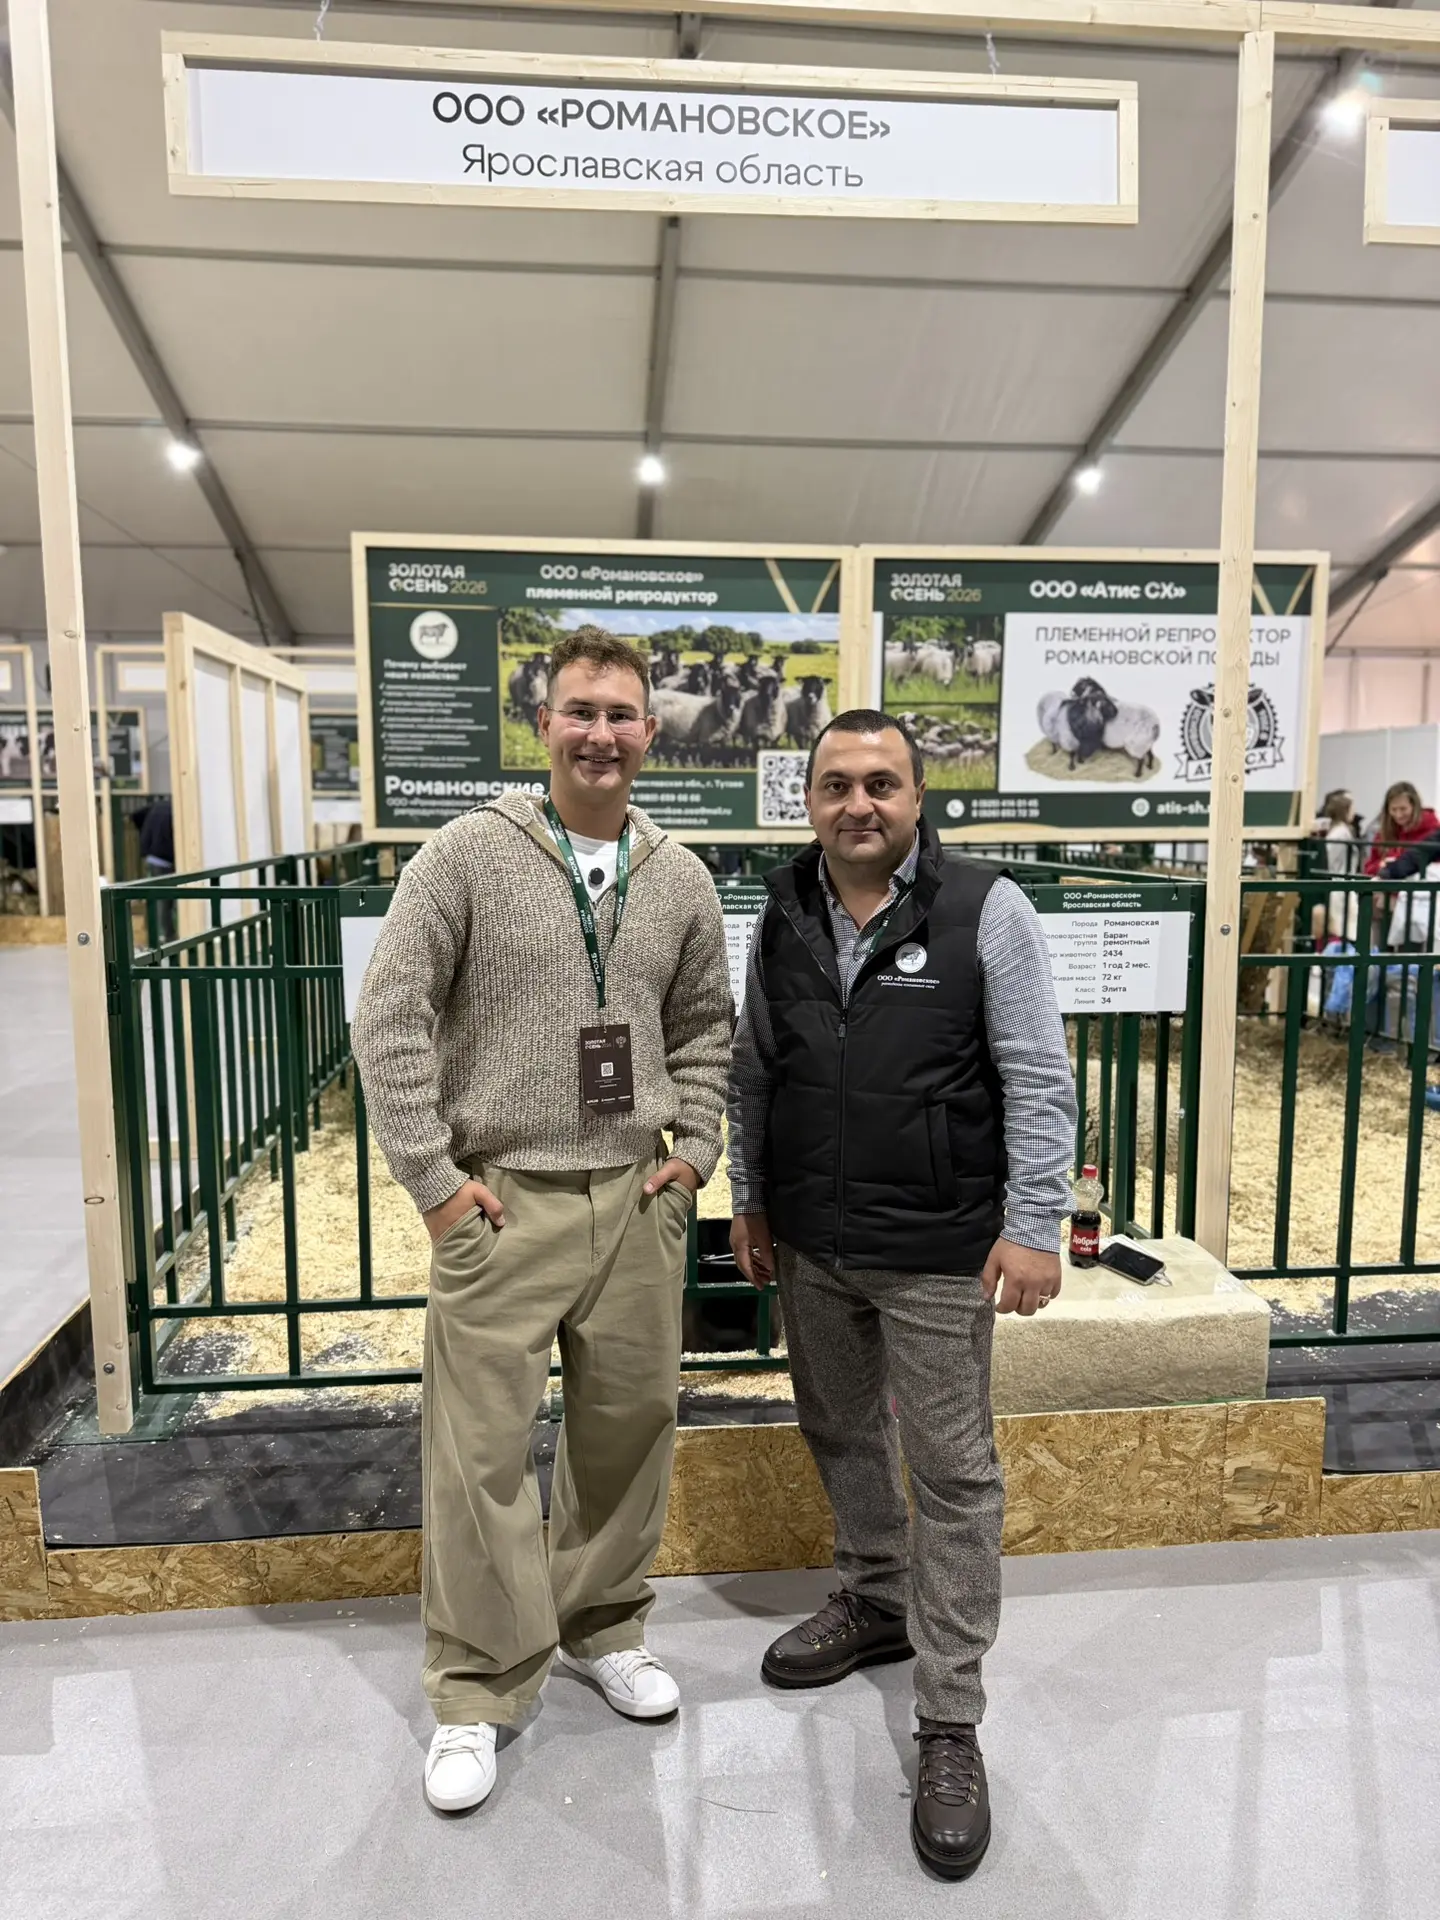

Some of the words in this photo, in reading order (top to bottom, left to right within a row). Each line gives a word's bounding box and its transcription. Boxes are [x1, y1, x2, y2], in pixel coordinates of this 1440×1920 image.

[432, 91, 525, 126] ООО
[537, 98, 891, 140] «РОМАНОВСКОЕ»
[462, 143, 703, 182] Ярославская
[716, 153, 864, 187] область
[388, 563, 466, 579] ЗОЛОТАЯ
[540, 565, 578, 580] ООО
[580, 566, 704, 584] «Романовское»
[388, 578, 449, 593] ОСЕНЬ
[450, 580, 488, 594] 2026
[890, 573, 962, 588] ЗОЛОТАЯ
[526, 585, 613, 601] племенной
[615, 588, 719, 606] репродуктор
[890, 588, 945, 601] ОСЕНЬ
[946, 588, 981, 602] 2026
[1029, 580, 1076, 599] ООО
[1080, 581, 1141, 599] «Атис
[1144, 582, 1187, 600] СХ»
[1036, 623, 1150, 643] ПЛЕМЕННОЙ
[1156, 627, 1292, 644] РЕПРОТОР
[1045, 646, 1192, 665] РОМАНОВСКОЙ
[1198, 651, 1280, 668] ПДЫ
[385, 775, 545, 797] Романовские
[1157, 799, 1211, 815] atis-sh.
[723, 893, 769, 901] «Романовс
[1063, 892, 1082, 900] ООО
[1082, 892, 1142, 900] «Романовское»
[1063, 901, 1110, 909] Ярославская
[1111, 900, 1142, 909] область
[1103, 919, 1160, 927] Романовская
[1103, 938, 1150, 947] ремонтный
[1108, 962, 1123, 970] год
[1101, 985, 1127, 993] Элита
